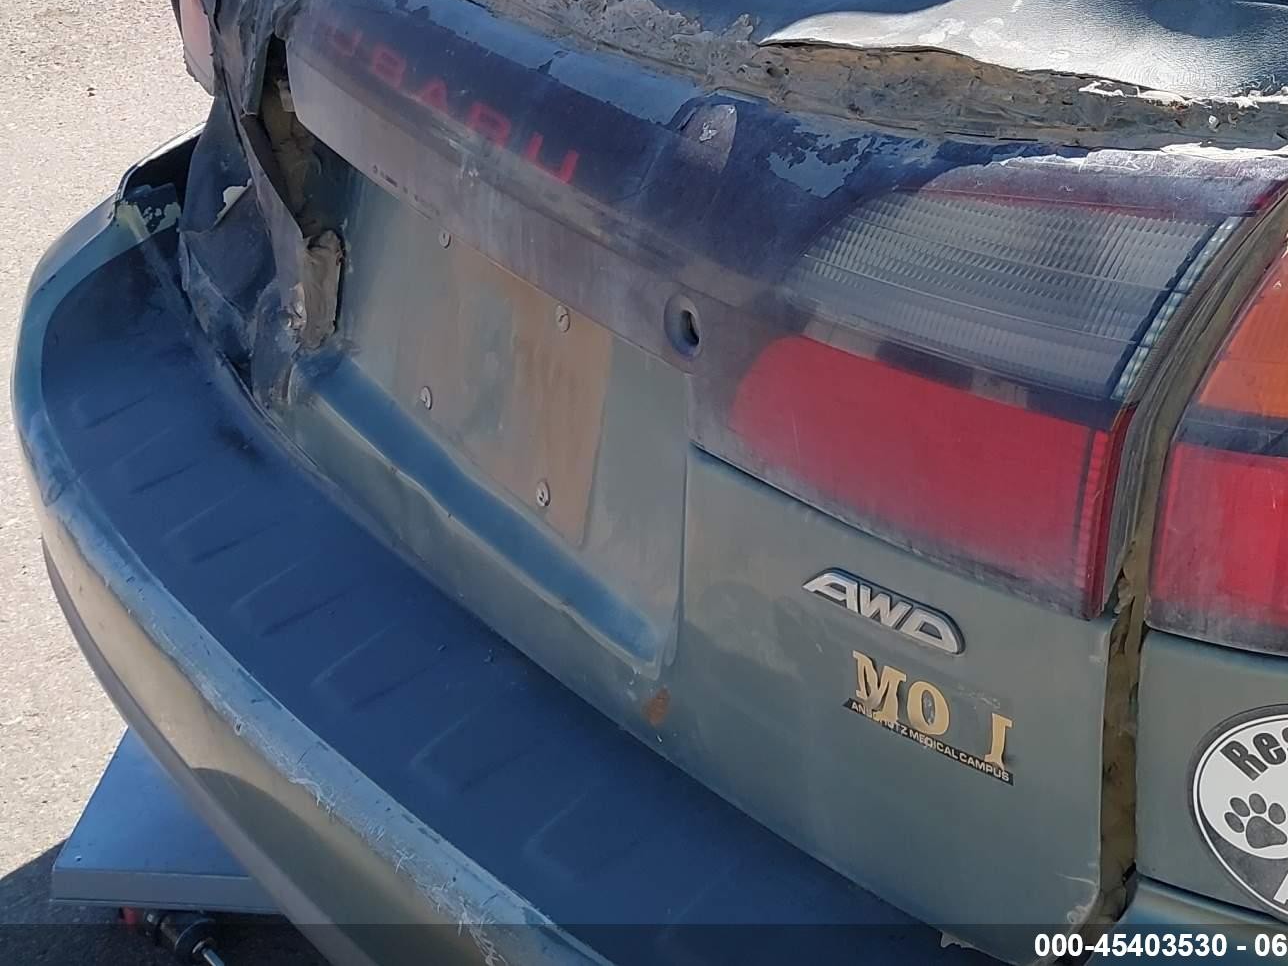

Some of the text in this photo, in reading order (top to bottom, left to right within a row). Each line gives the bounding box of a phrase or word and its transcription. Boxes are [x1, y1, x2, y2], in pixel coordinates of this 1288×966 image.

[316, 16, 581, 185] UBARU
[802, 571, 963, 655] AWD
[909, 729, 959, 759] MEDICAL
[960, 753, 1010, 782] CAMPUS
